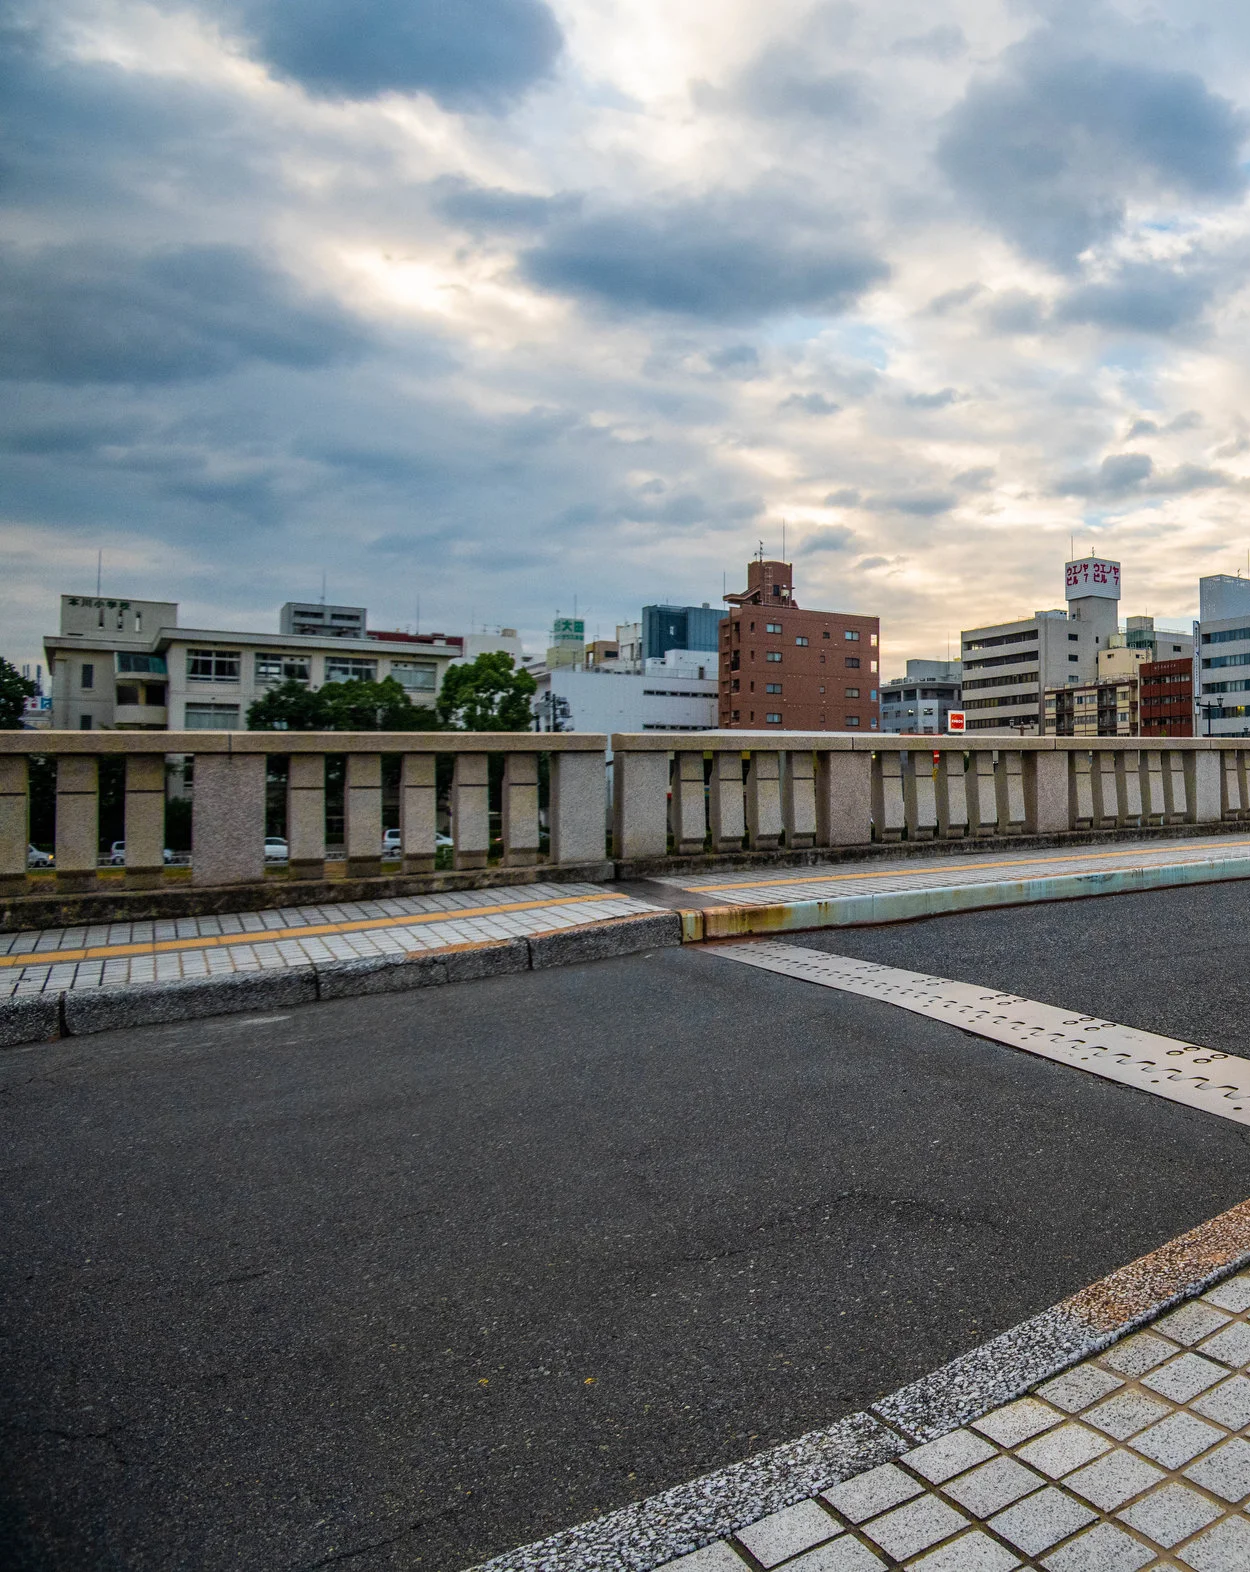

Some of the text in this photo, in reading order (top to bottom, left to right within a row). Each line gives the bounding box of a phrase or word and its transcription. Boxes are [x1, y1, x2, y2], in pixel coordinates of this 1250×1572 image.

[1066, 563, 1089, 576] ウエノヤ
[1093, 563, 1120, 575] ウエノヤ
[1093, 573, 1107, 584] ビル
